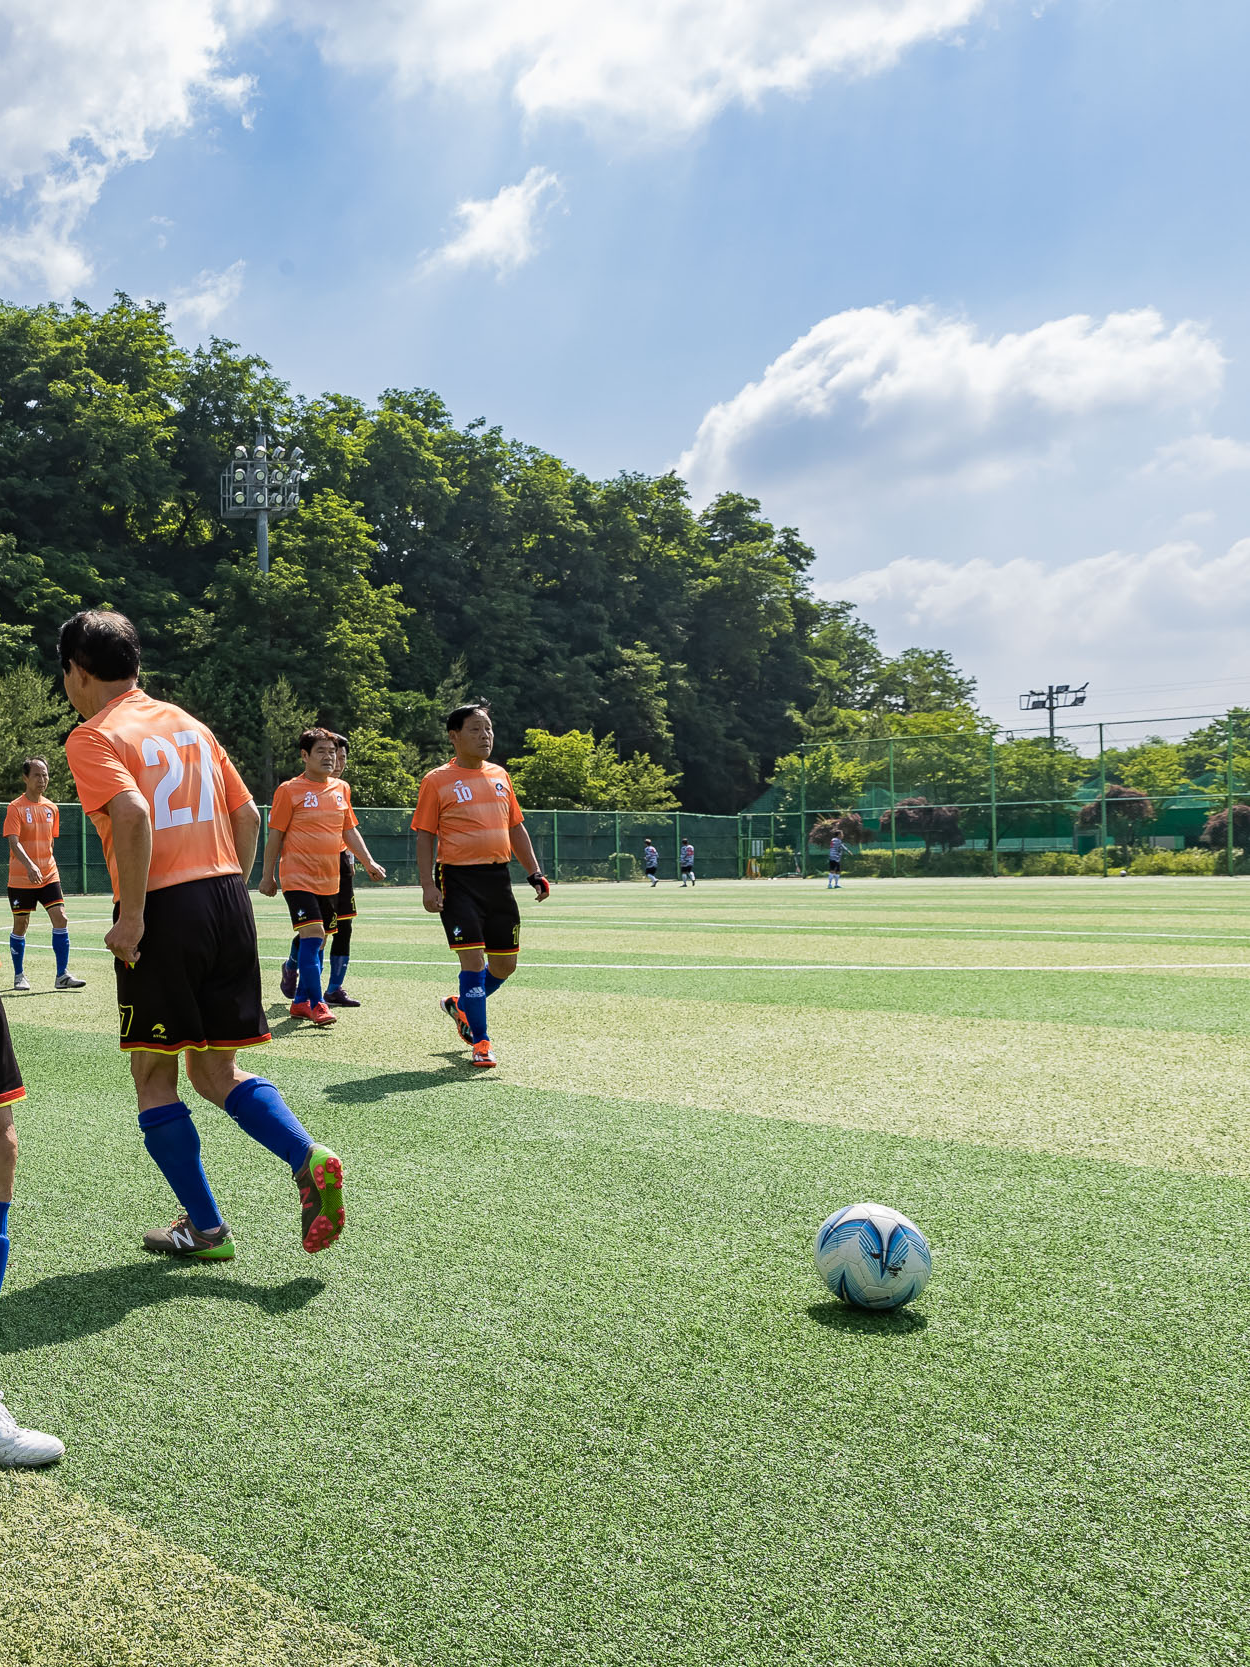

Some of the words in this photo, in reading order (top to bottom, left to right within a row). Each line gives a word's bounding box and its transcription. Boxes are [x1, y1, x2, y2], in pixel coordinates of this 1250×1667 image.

[141, 730, 215, 831] 27
[303, 794, 319, 808] 23
[453, 786, 473, 803] 10
[329, 912, 338, 928] 2
[512, 925, 521, 945] 1
[172, 1227, 195, 1249] N
